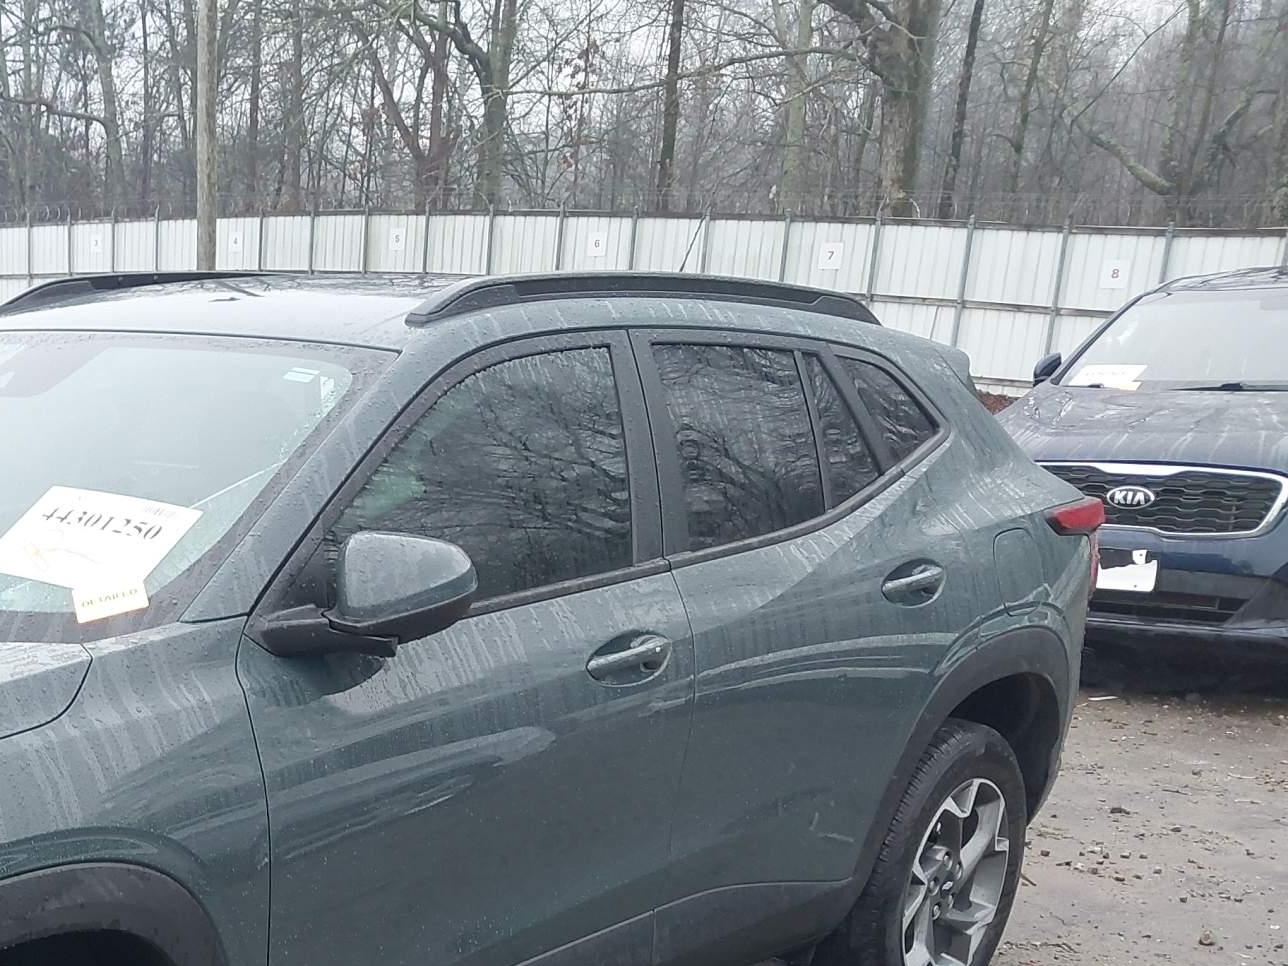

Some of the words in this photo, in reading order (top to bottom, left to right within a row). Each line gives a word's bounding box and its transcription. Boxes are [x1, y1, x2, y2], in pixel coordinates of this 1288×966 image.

[827, 250, 835, 260] 7
[1111, 268, 1120, 279] 8
[1113, 490, 1146, 505] KIA
[42, 507, 163, 540] 44301250
